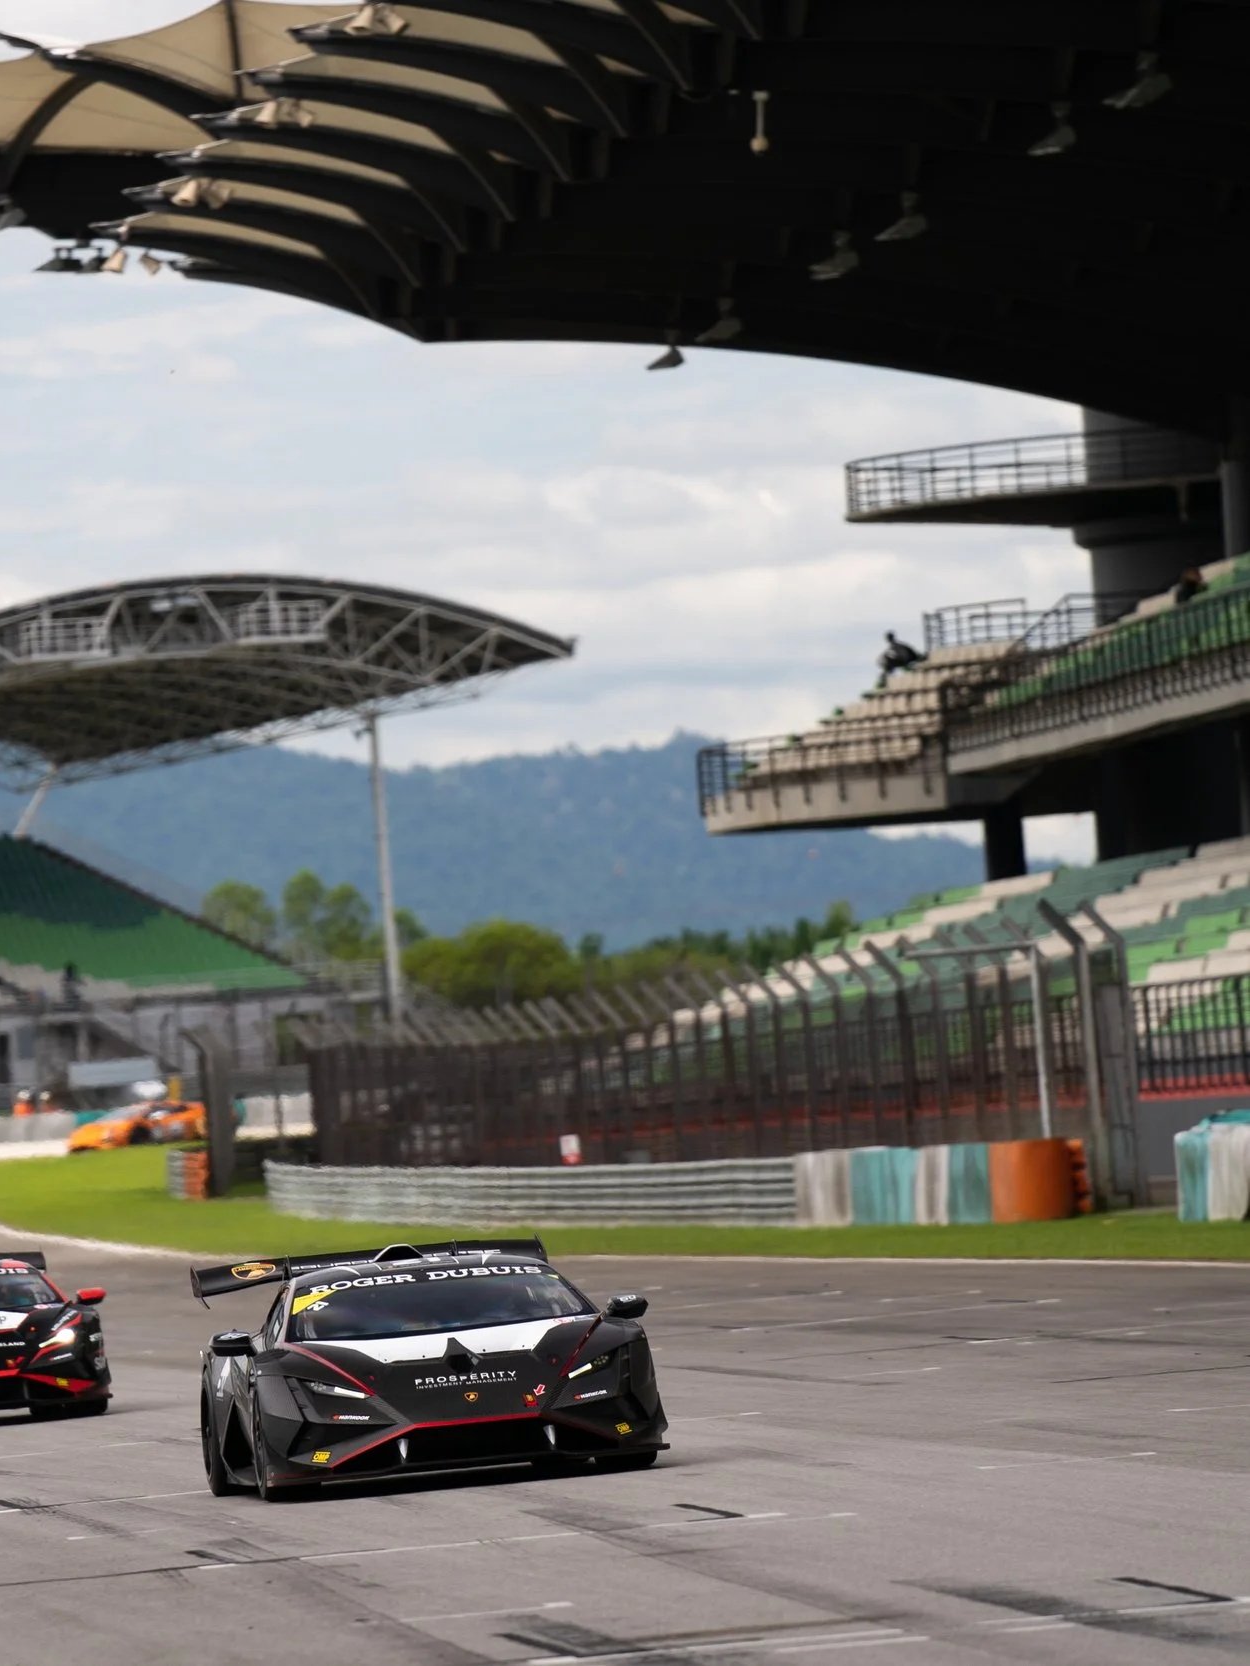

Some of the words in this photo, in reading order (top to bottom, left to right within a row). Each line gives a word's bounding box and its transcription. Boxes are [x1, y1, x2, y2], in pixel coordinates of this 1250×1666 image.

[309, 1274, 417, 1296] ROGER
[426, 1265, 542, 1281] DUBUIS
[414, 1370, 517, 1386] PROSPERITY
[416, 1381, 463, 1390] INVESTMENT
[465, 1377, 518, 1385] MANAGEMENT
